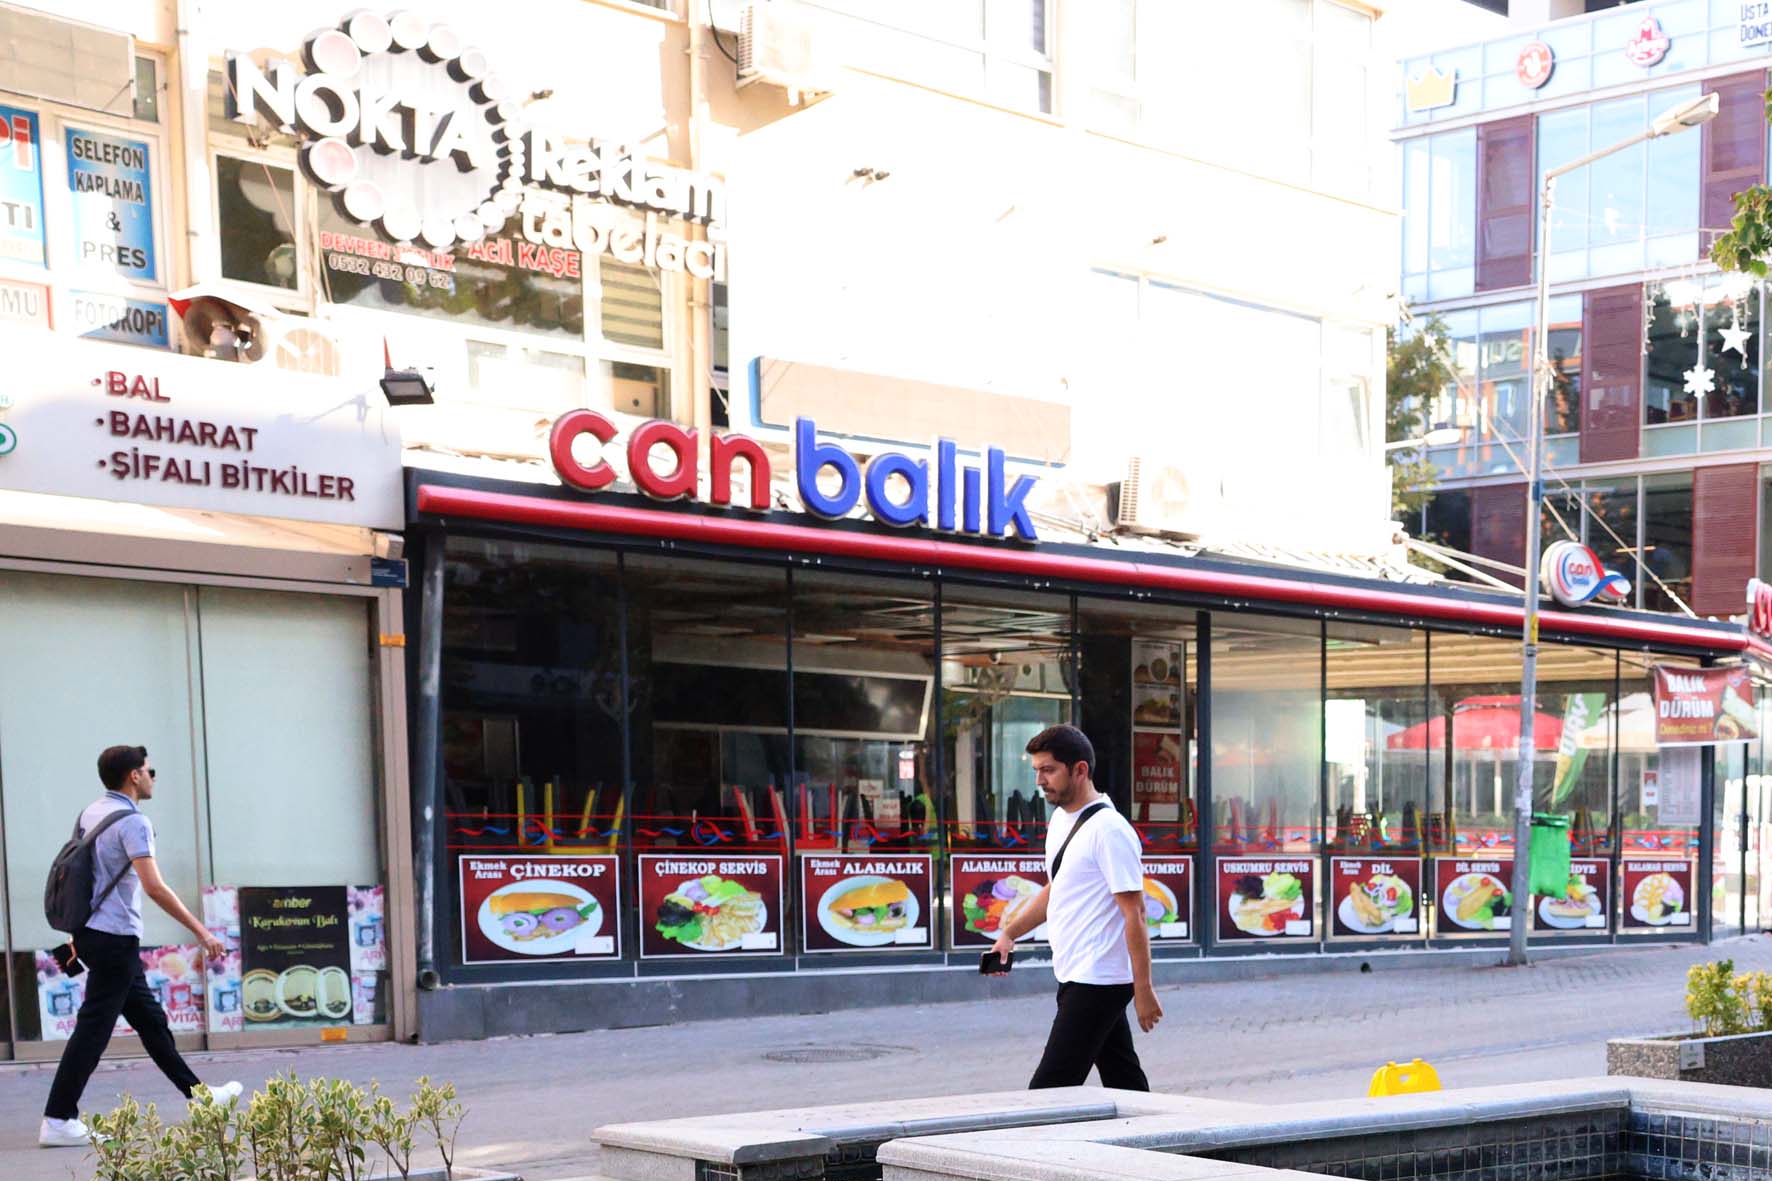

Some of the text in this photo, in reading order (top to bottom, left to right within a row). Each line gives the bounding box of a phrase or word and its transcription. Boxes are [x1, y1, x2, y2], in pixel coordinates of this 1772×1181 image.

[230, 50, 480, 170] NOKTA
[72, 136, 144, 170] SELEFON
[529, 122, 728, 220] Reklam
[74, 170, 144, 204] KAPLAMA
[105, 211, 121, 233] &
[82, 240, 147, 270] PRES
[467, 238, 582, 279] Acil KAŞE
[107, 369, 171, 402] BAL
[109, 410, 259, 452] BAHARAT
[110, 447, 356, 502] ŞİFALI BİTKİLER
[550, 408, 1042, 542] can balık
[1666, 674, 1707, 693] BALIK
[1660, 695, 1715, 718] DÜRÜM
[1140, 765, 1175, 778] BALIK
[1135, 779, 1179, 794] DÜRÜM
[469, 860, 607, 880] Ekmek ÇİNEKOP
[655, 860, 768, 877] ÇİNEKOP SERVİS
[843, 862, 925, 875] ALABALIK
[961, 860, 1049, 874] ALABALIK SERV
[1141, 863, 1186, 876] KUMRU
[1223, 862, 1273, 874] USKUMRU
[1371, 863, 1394, 874] DİL
[1570, 862, 1598, 875] İDYE
